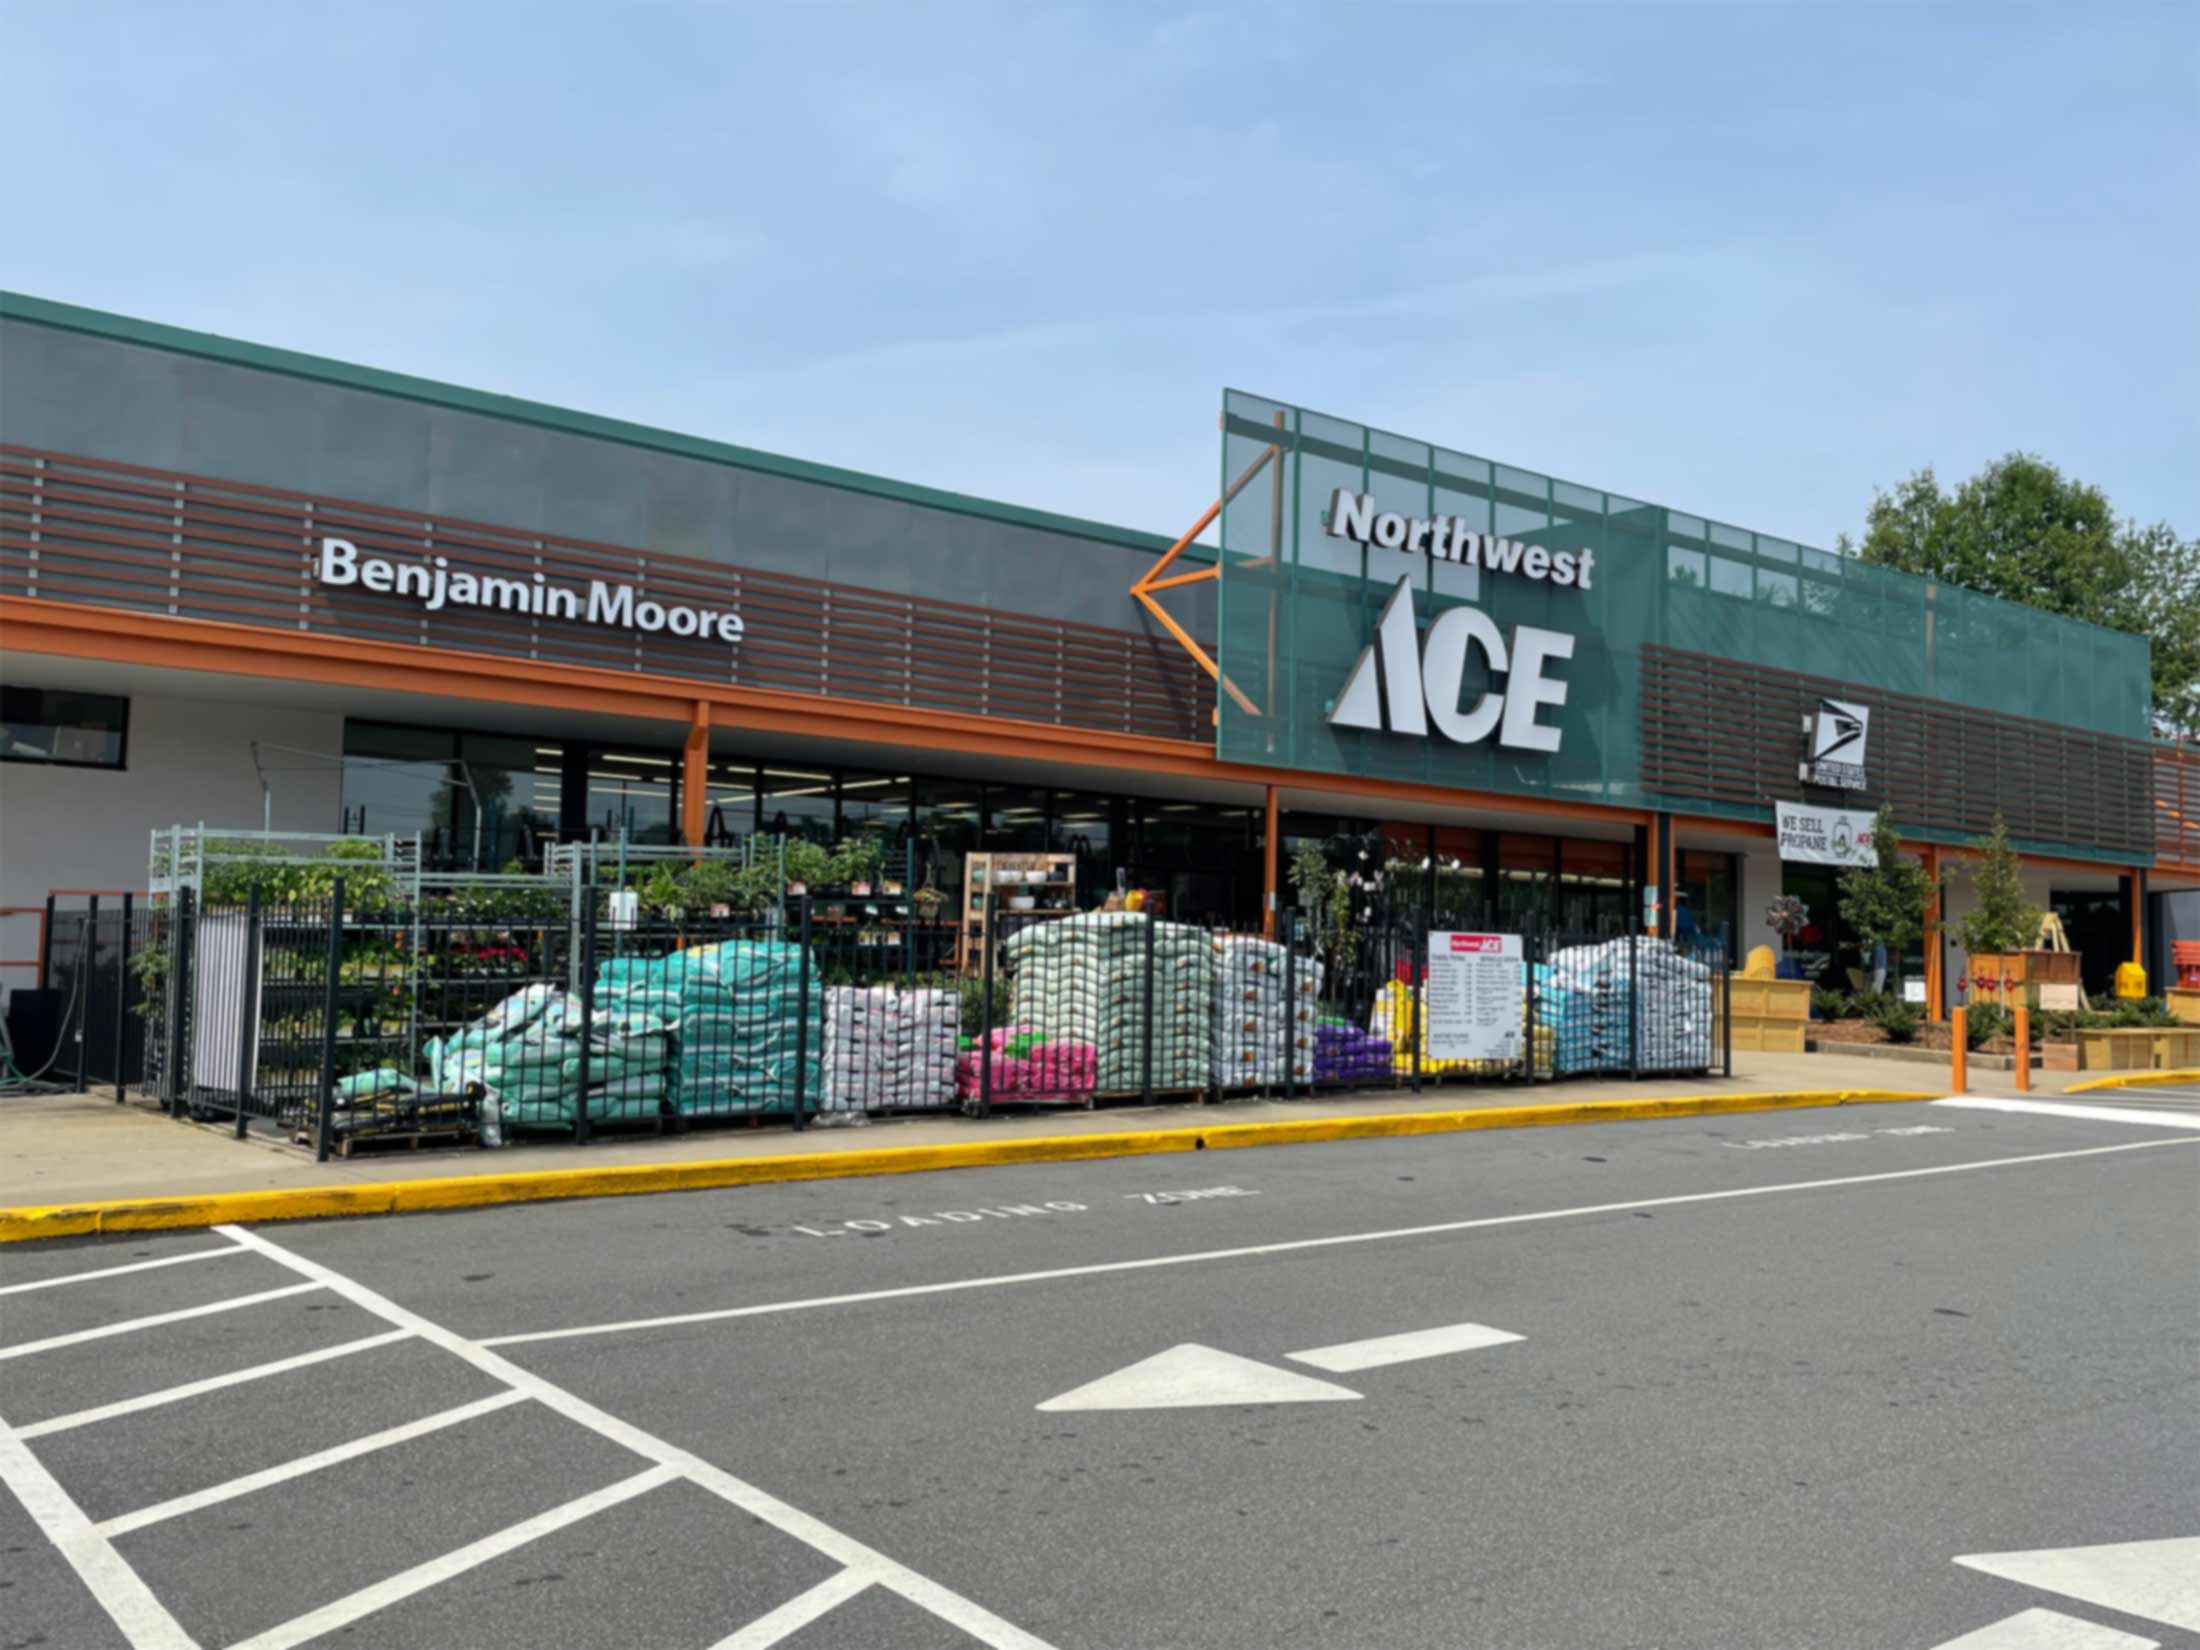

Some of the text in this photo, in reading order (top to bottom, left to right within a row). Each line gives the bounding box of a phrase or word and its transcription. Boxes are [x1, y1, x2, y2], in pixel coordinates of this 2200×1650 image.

[1329, 487, 1595, 589] Northwest
[320, 537, 745, 642] Benjamin Moore
[1329, 573, 1575, 752] ACE
[1780, 832, 1827, 851] PROPANE
[1782, 815, 1824, 833] WE SELL
[792, 1201, 1088, 1237] LOADING
